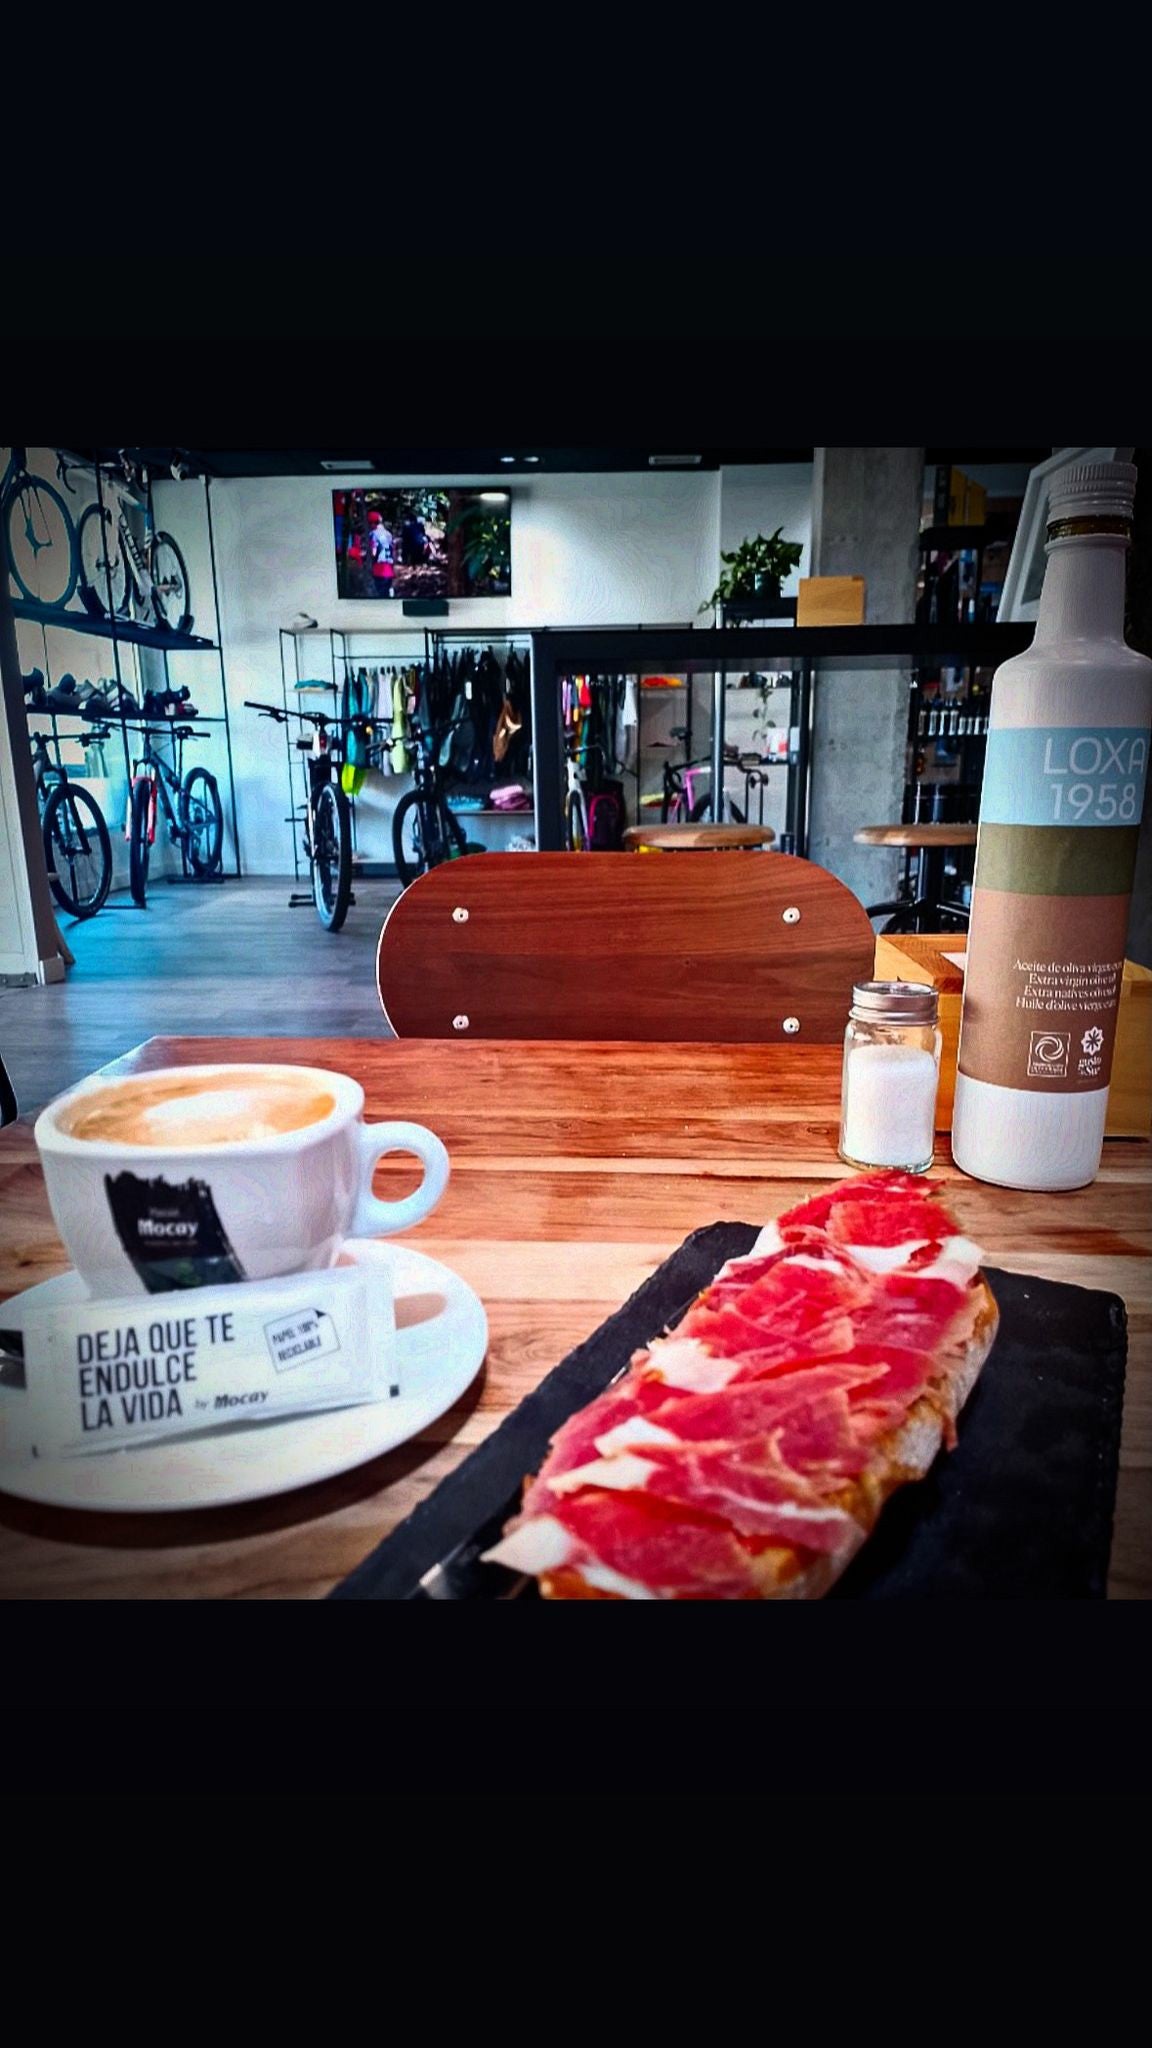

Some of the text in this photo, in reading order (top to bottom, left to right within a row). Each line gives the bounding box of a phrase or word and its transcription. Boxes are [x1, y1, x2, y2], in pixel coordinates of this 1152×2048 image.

[1043, 737, 1146, 775] LOXA
[1050, 783, 1136, 820] 1958
[1013, 959, 1047, 973] Aceite
[1047, 962, 1060, 973] de
[1062, 962, 1086, 973] oliva
[1024, 985, 1053, 998] Extra
[1029, 973, 1058, 985] Extra
[1059, 975, 1088, 988] virgin
[1015, 996, 1045, 1010] Huile
[137, 1218, 199, 1238] Mocay
[77, 1312, 235, 1365] DEJA QUE TE
[79, 1351, 198, 1398] ENDULCE
[81, 1389, 269, 1433] LA VIDA by Mocay
